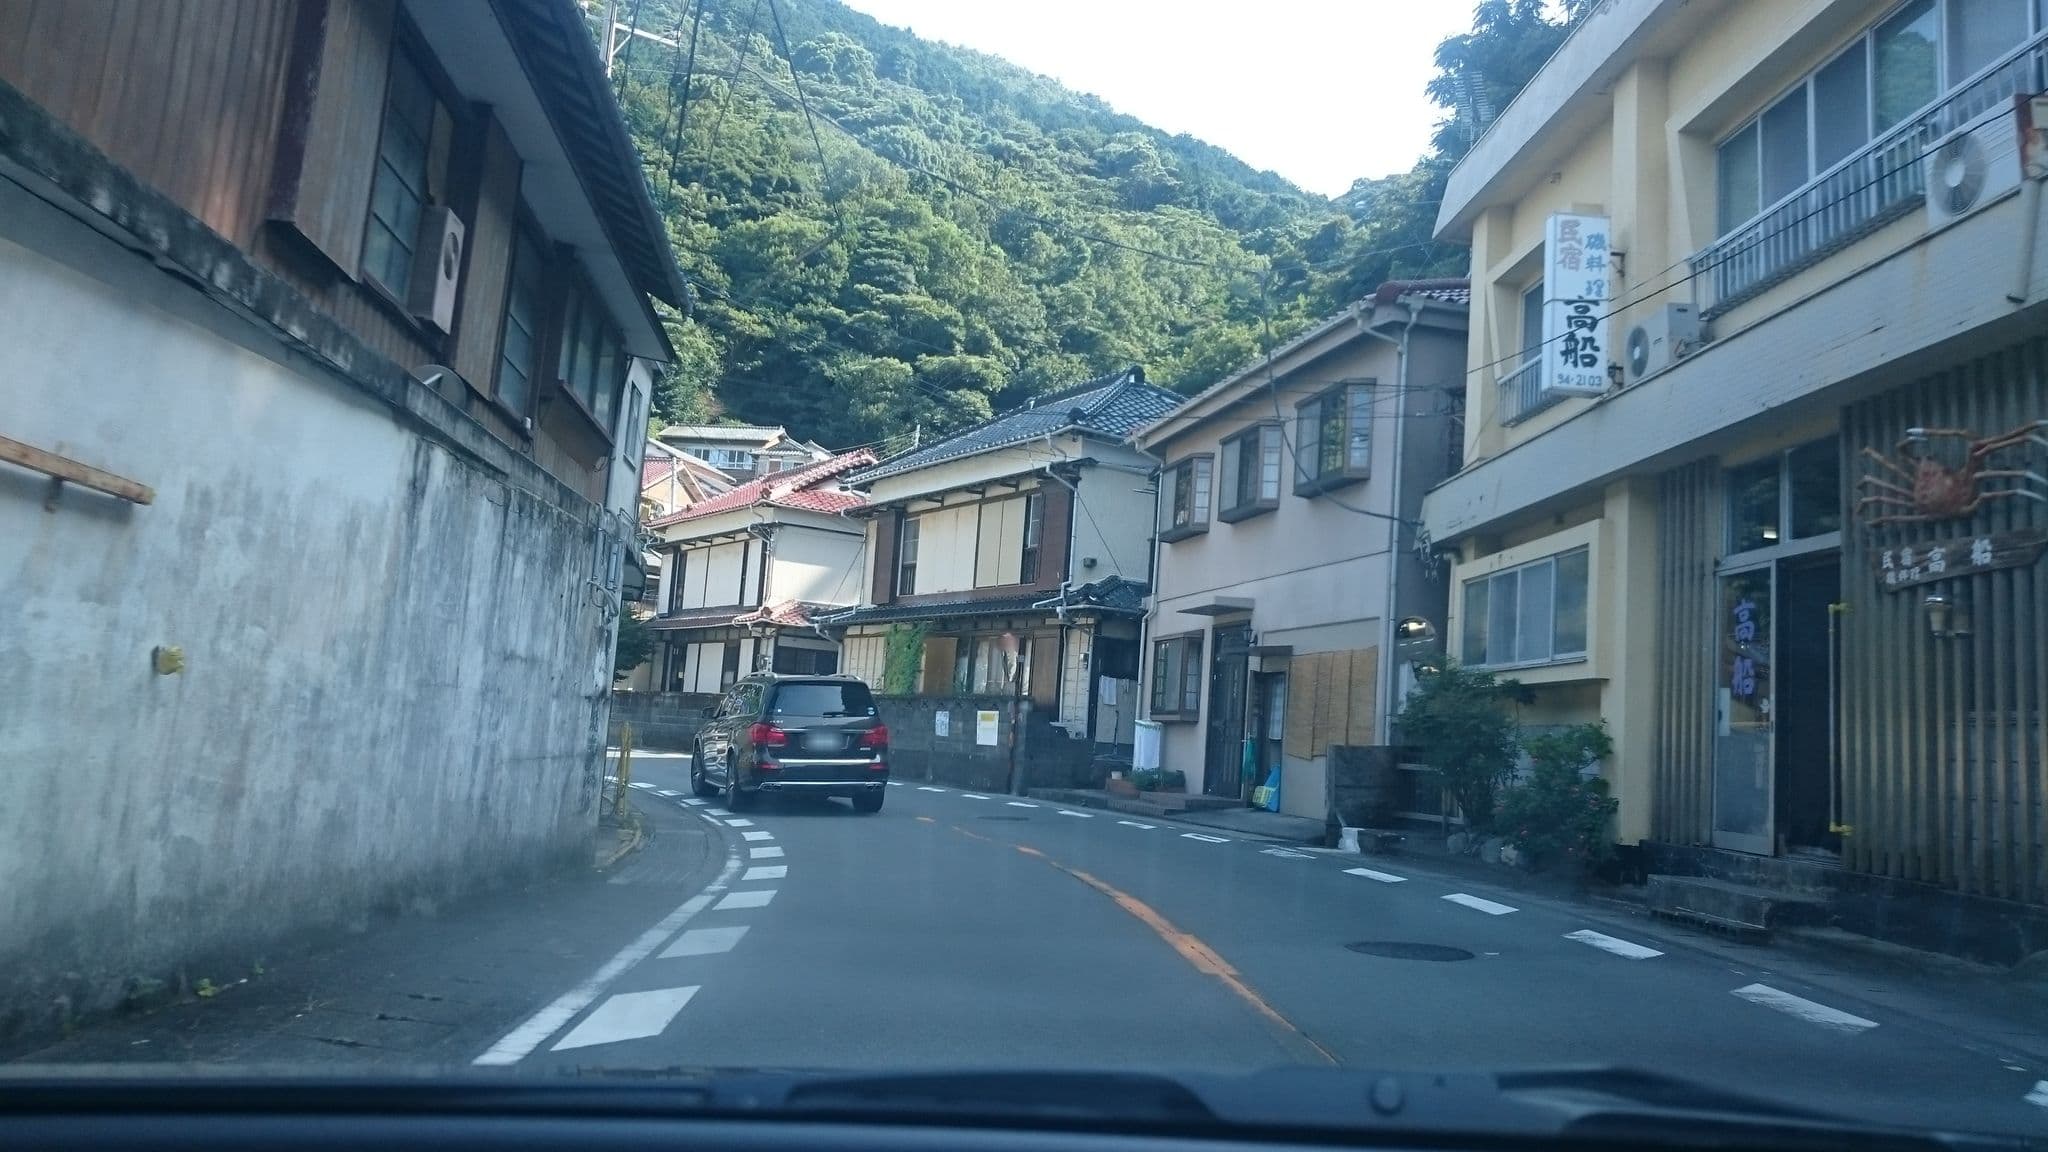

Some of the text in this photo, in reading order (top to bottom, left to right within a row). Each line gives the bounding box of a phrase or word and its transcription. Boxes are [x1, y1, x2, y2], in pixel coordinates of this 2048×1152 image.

[1557, 219, 1582, 272] 民宿
[1584, 232, 1606, 298] 磯料理
[1560, 295, 1600, 368] 高船
[1928, 538, 1993, 574] 高船
[1732, 598, 1756, 696] 高船
